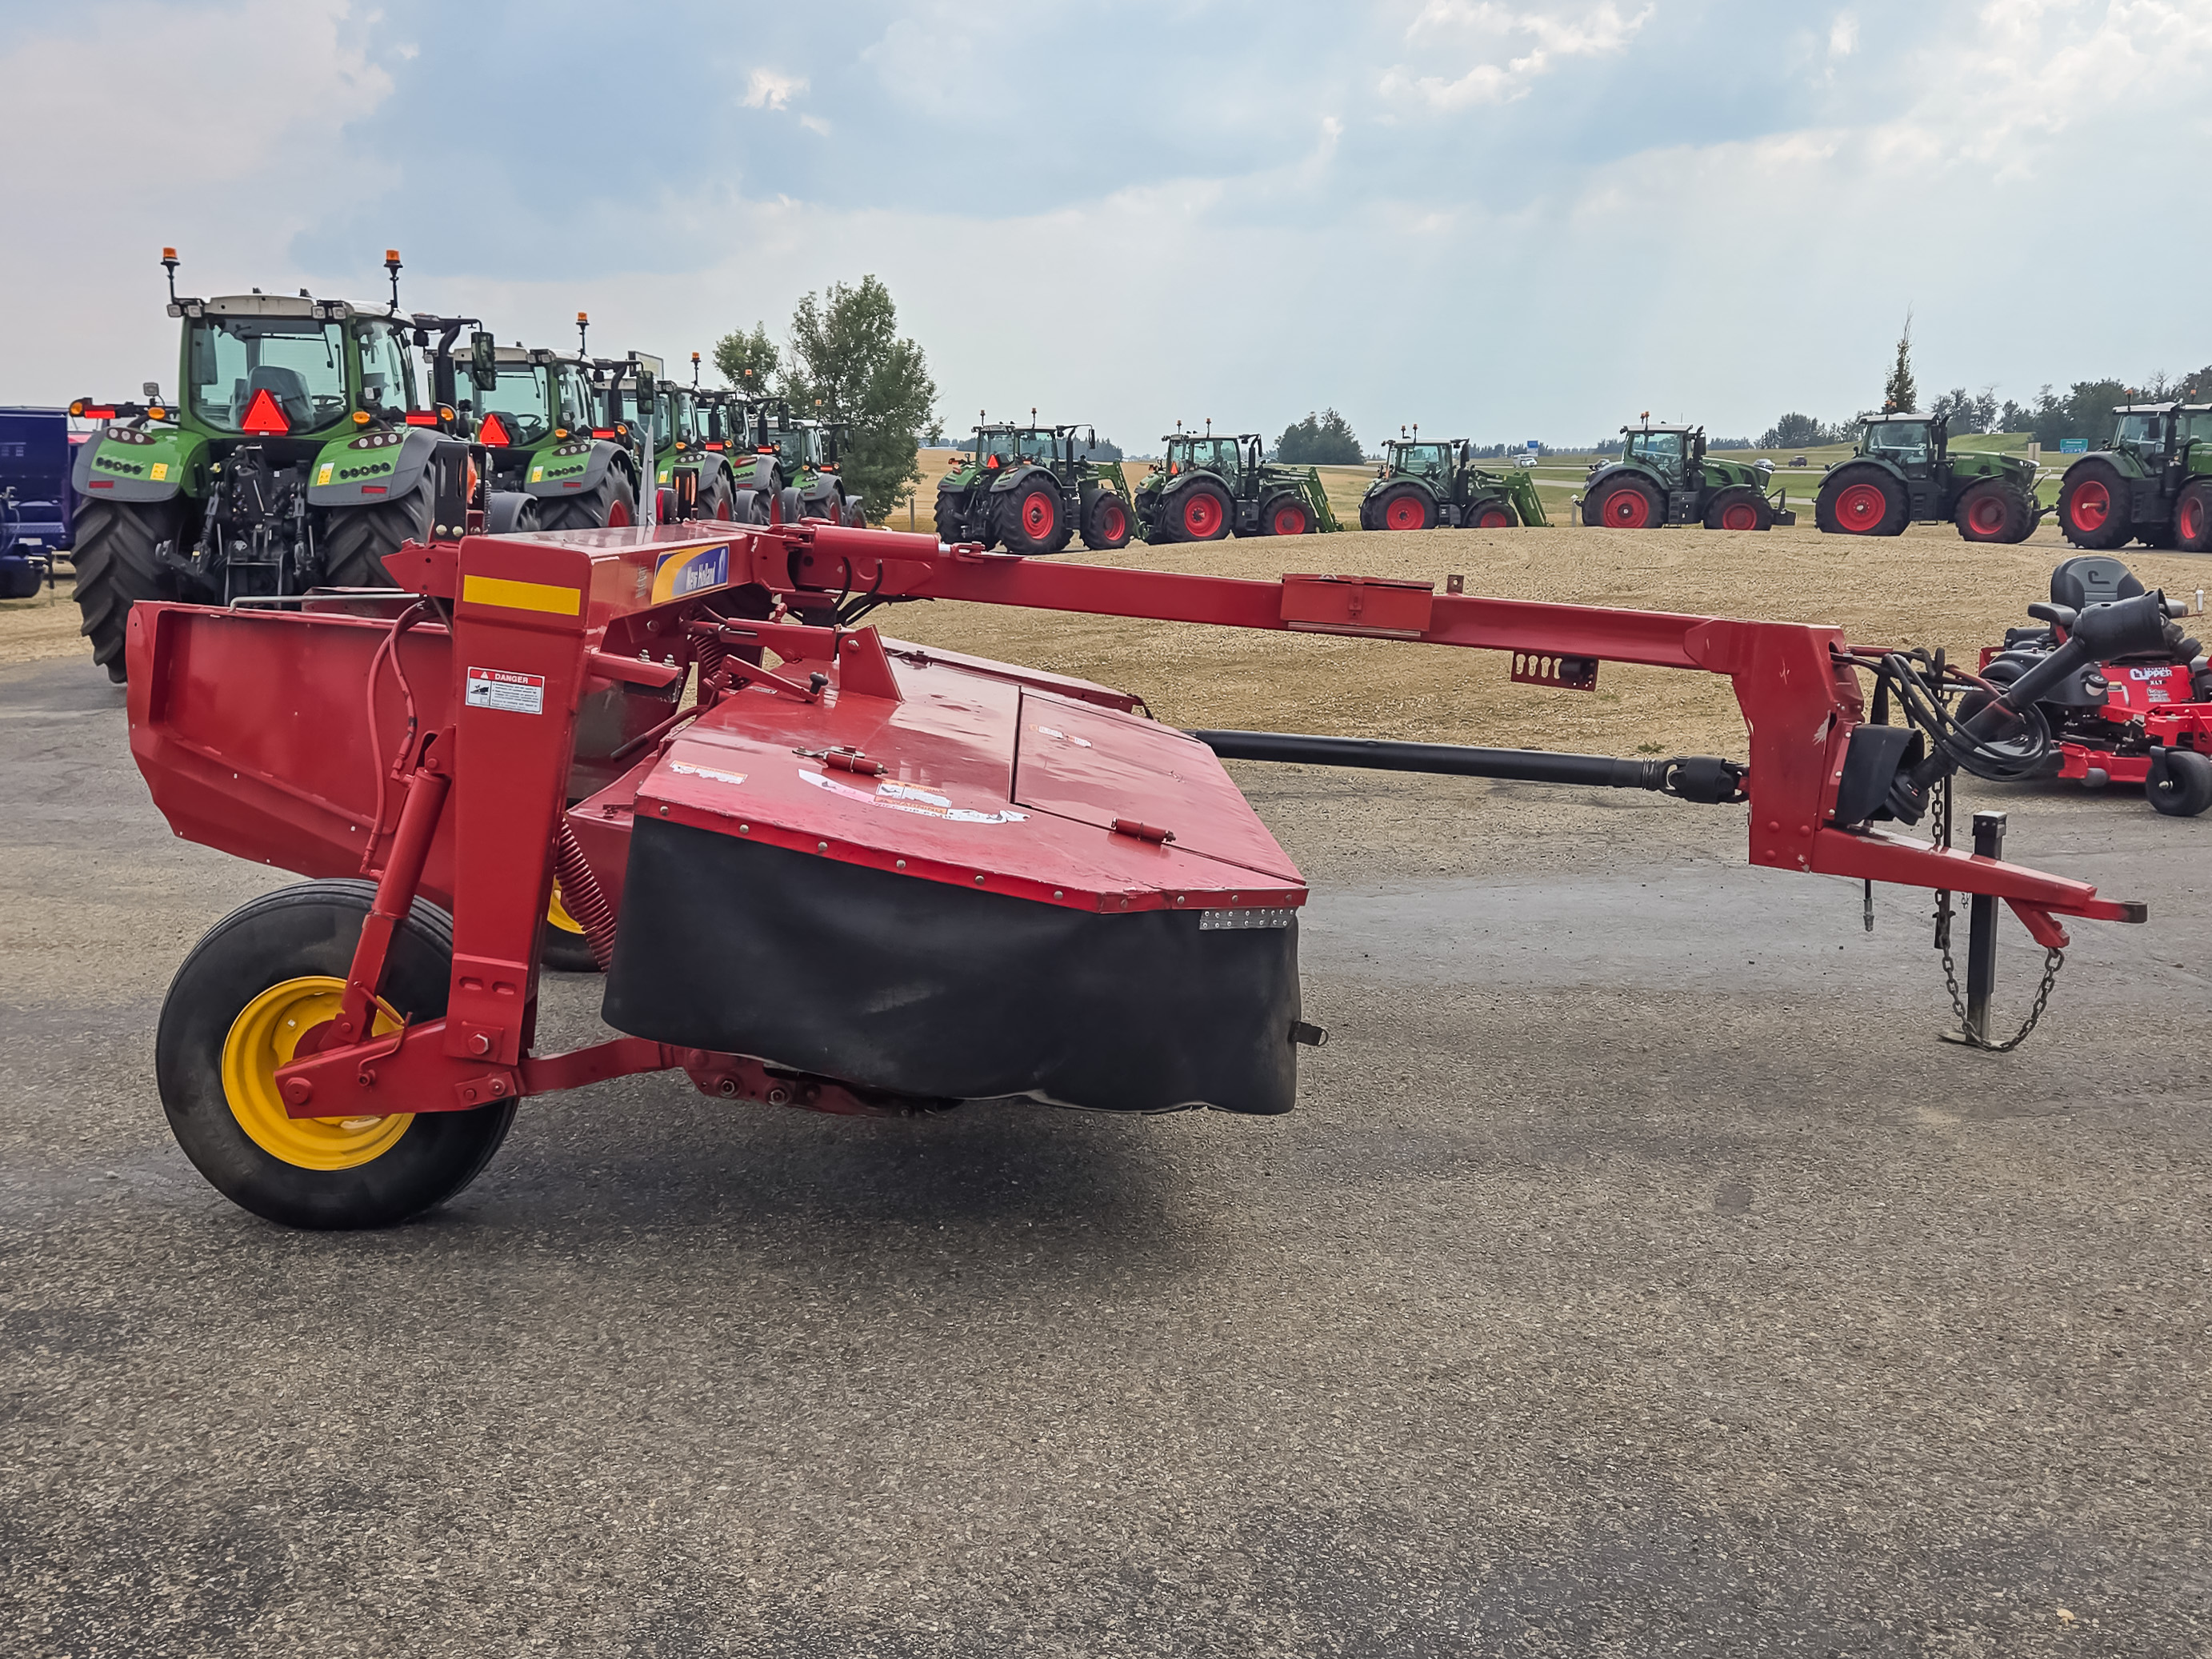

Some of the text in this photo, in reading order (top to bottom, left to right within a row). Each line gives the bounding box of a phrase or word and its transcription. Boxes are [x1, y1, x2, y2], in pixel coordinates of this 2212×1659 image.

[686, 561, 716, 591] New Holland
[494, 673, 529, 684] DANGER
